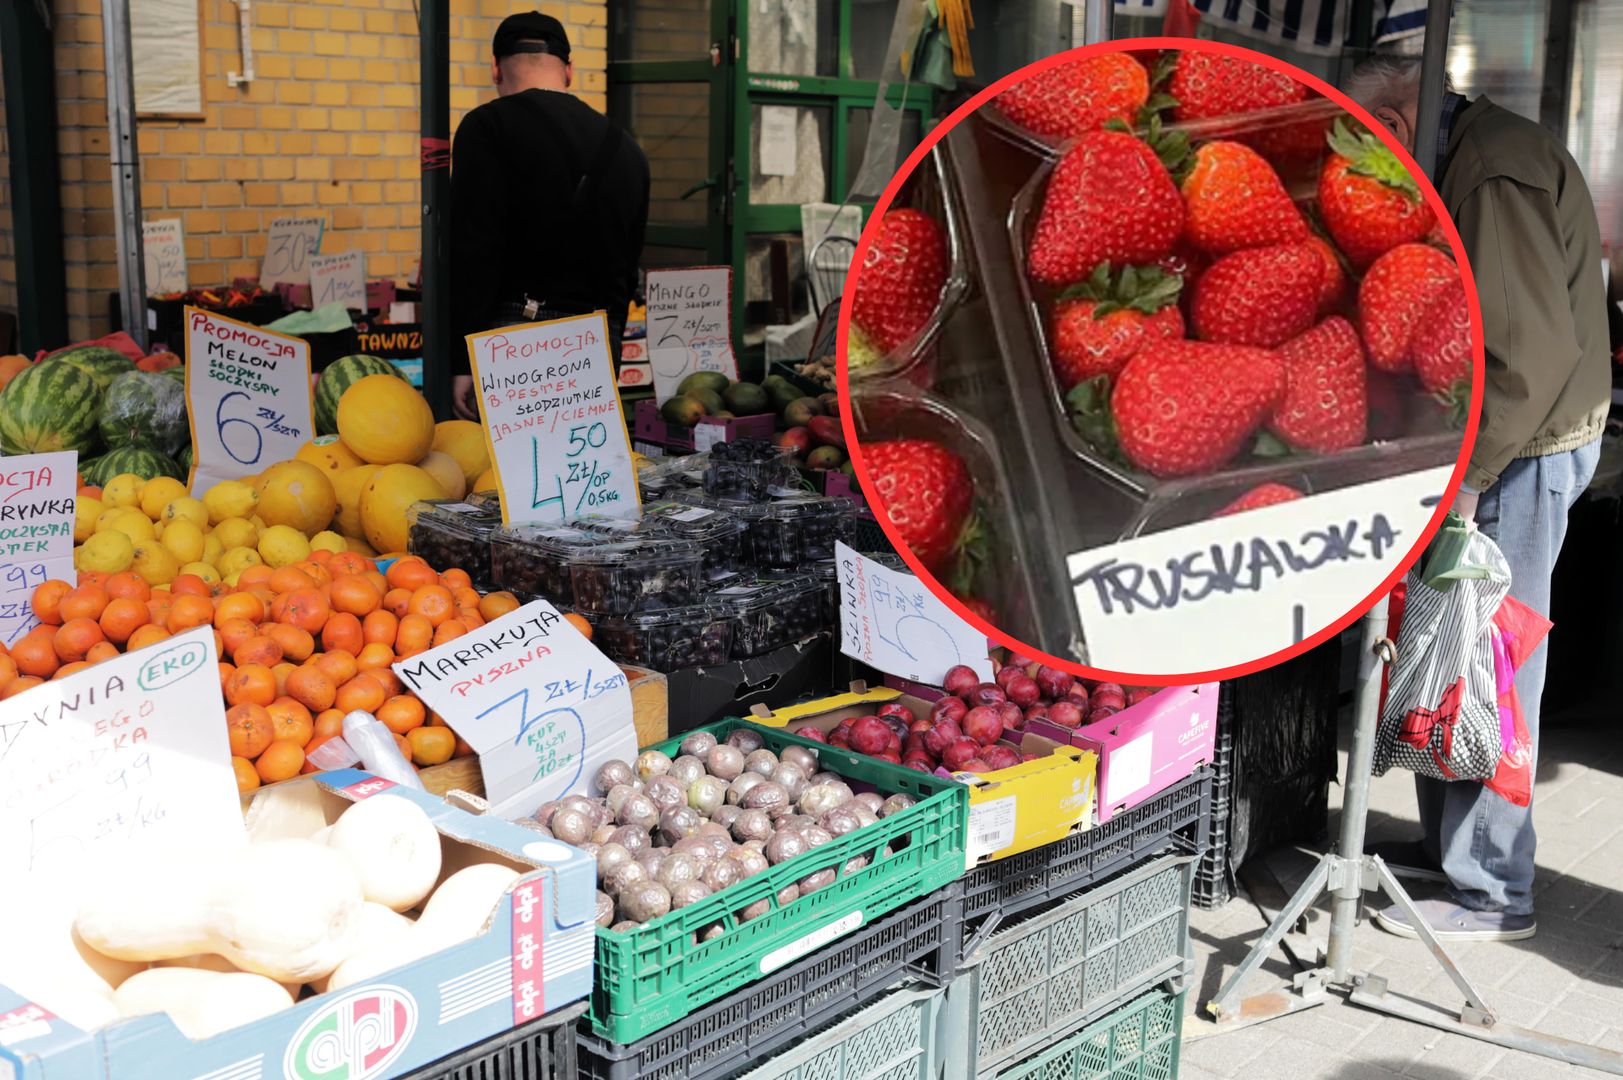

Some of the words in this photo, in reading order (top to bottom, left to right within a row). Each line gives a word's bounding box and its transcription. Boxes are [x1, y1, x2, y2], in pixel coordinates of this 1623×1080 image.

[648, 282, 711, 302] MANGO
[191, 311, 297, 359] PROMOCJA
[357, 331, 423, 352] TAWNZ
[484, 330, 596, 364] PROMOCJA
[207, 341, 278, 371] MELON
[209, 359, 263, 381] SŁODKI
[481, 357, 592, 393] WINOGRONA
[505, 378, 578, 403] PESTEK
[515, 385, 604, 416] SŁODZIUTKIE
[216, 390, 263, 465] 6
[531, 436, 566, 520] 4
[565, 421, 608, 458] 50
[1, 498, 75, 521] RYNKA
[402, 610, 561, 690] MARAKUJA
[146, 650, 197, 682] EKO
[450, 644, 552, 698] PYSZNA
[527, 721, 556, 746] KUP
[1178, 719, 1210, 744] CAREFIVE
[537, 749, 557, 764] ZA
